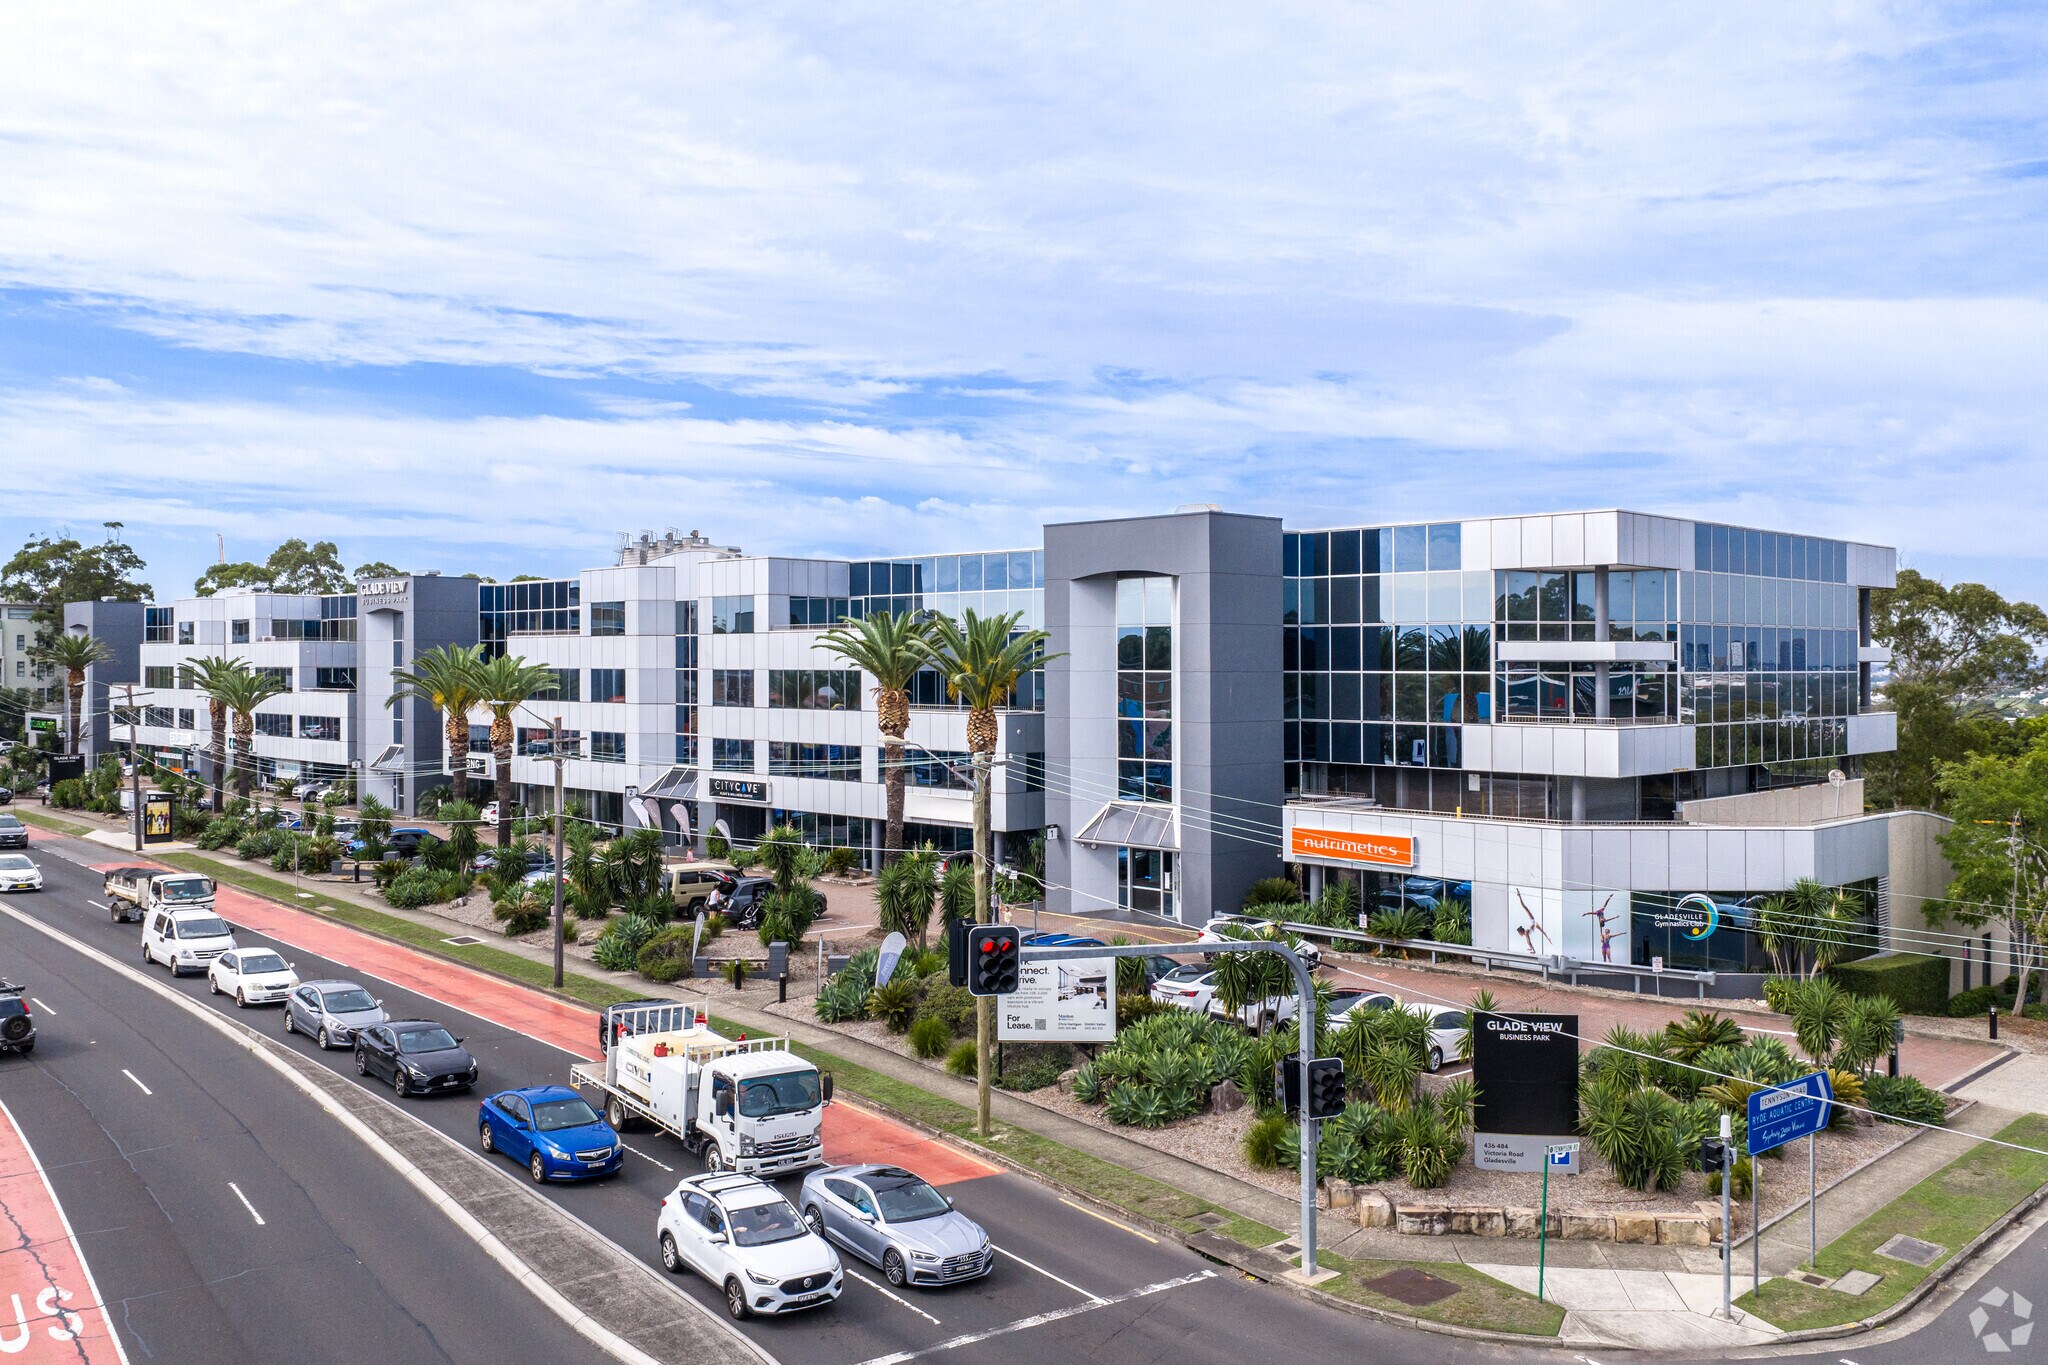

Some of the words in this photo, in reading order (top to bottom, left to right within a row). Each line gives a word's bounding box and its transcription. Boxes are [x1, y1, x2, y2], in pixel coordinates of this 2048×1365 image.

[360, 582, 386, 596] GLADE
[386, 580, 408, 594] VIEW
[362, 597, 391, 606] BUSINESS
[1303, 838, 1398, 857] nutrimetics
[1654, 920, 1689, 929] Gymnastics
[880, 953, 895, 976] PHYSIO
[1020, 966, 1050, 975] nnect.
[1019, 976, 1038, 984] rive.
[1006, 1014, 1021, 1022] For
[1006, 1022, 1033, 1030] Lease.
[1486, 1020, 1528, 1032] GLADE
[1531, 1022, 1564, 1032] VIEW
[1499, 1033, 1532, 1041] BUSINESS
[1761, 1092, 1790, 1107] TENNYSON
[1752, 1112, 1767, 1126] RYDE
[1769, 1103, 1792, 1118] AQUATIC
[1794, 1097, 1815, 1111] CENTRE
[773, 1131, 798, 1140] ISUZU
[1483, 1149, 1507, 1157] Victoria
[1483, 1157, 1517, 1165] Gladesville
